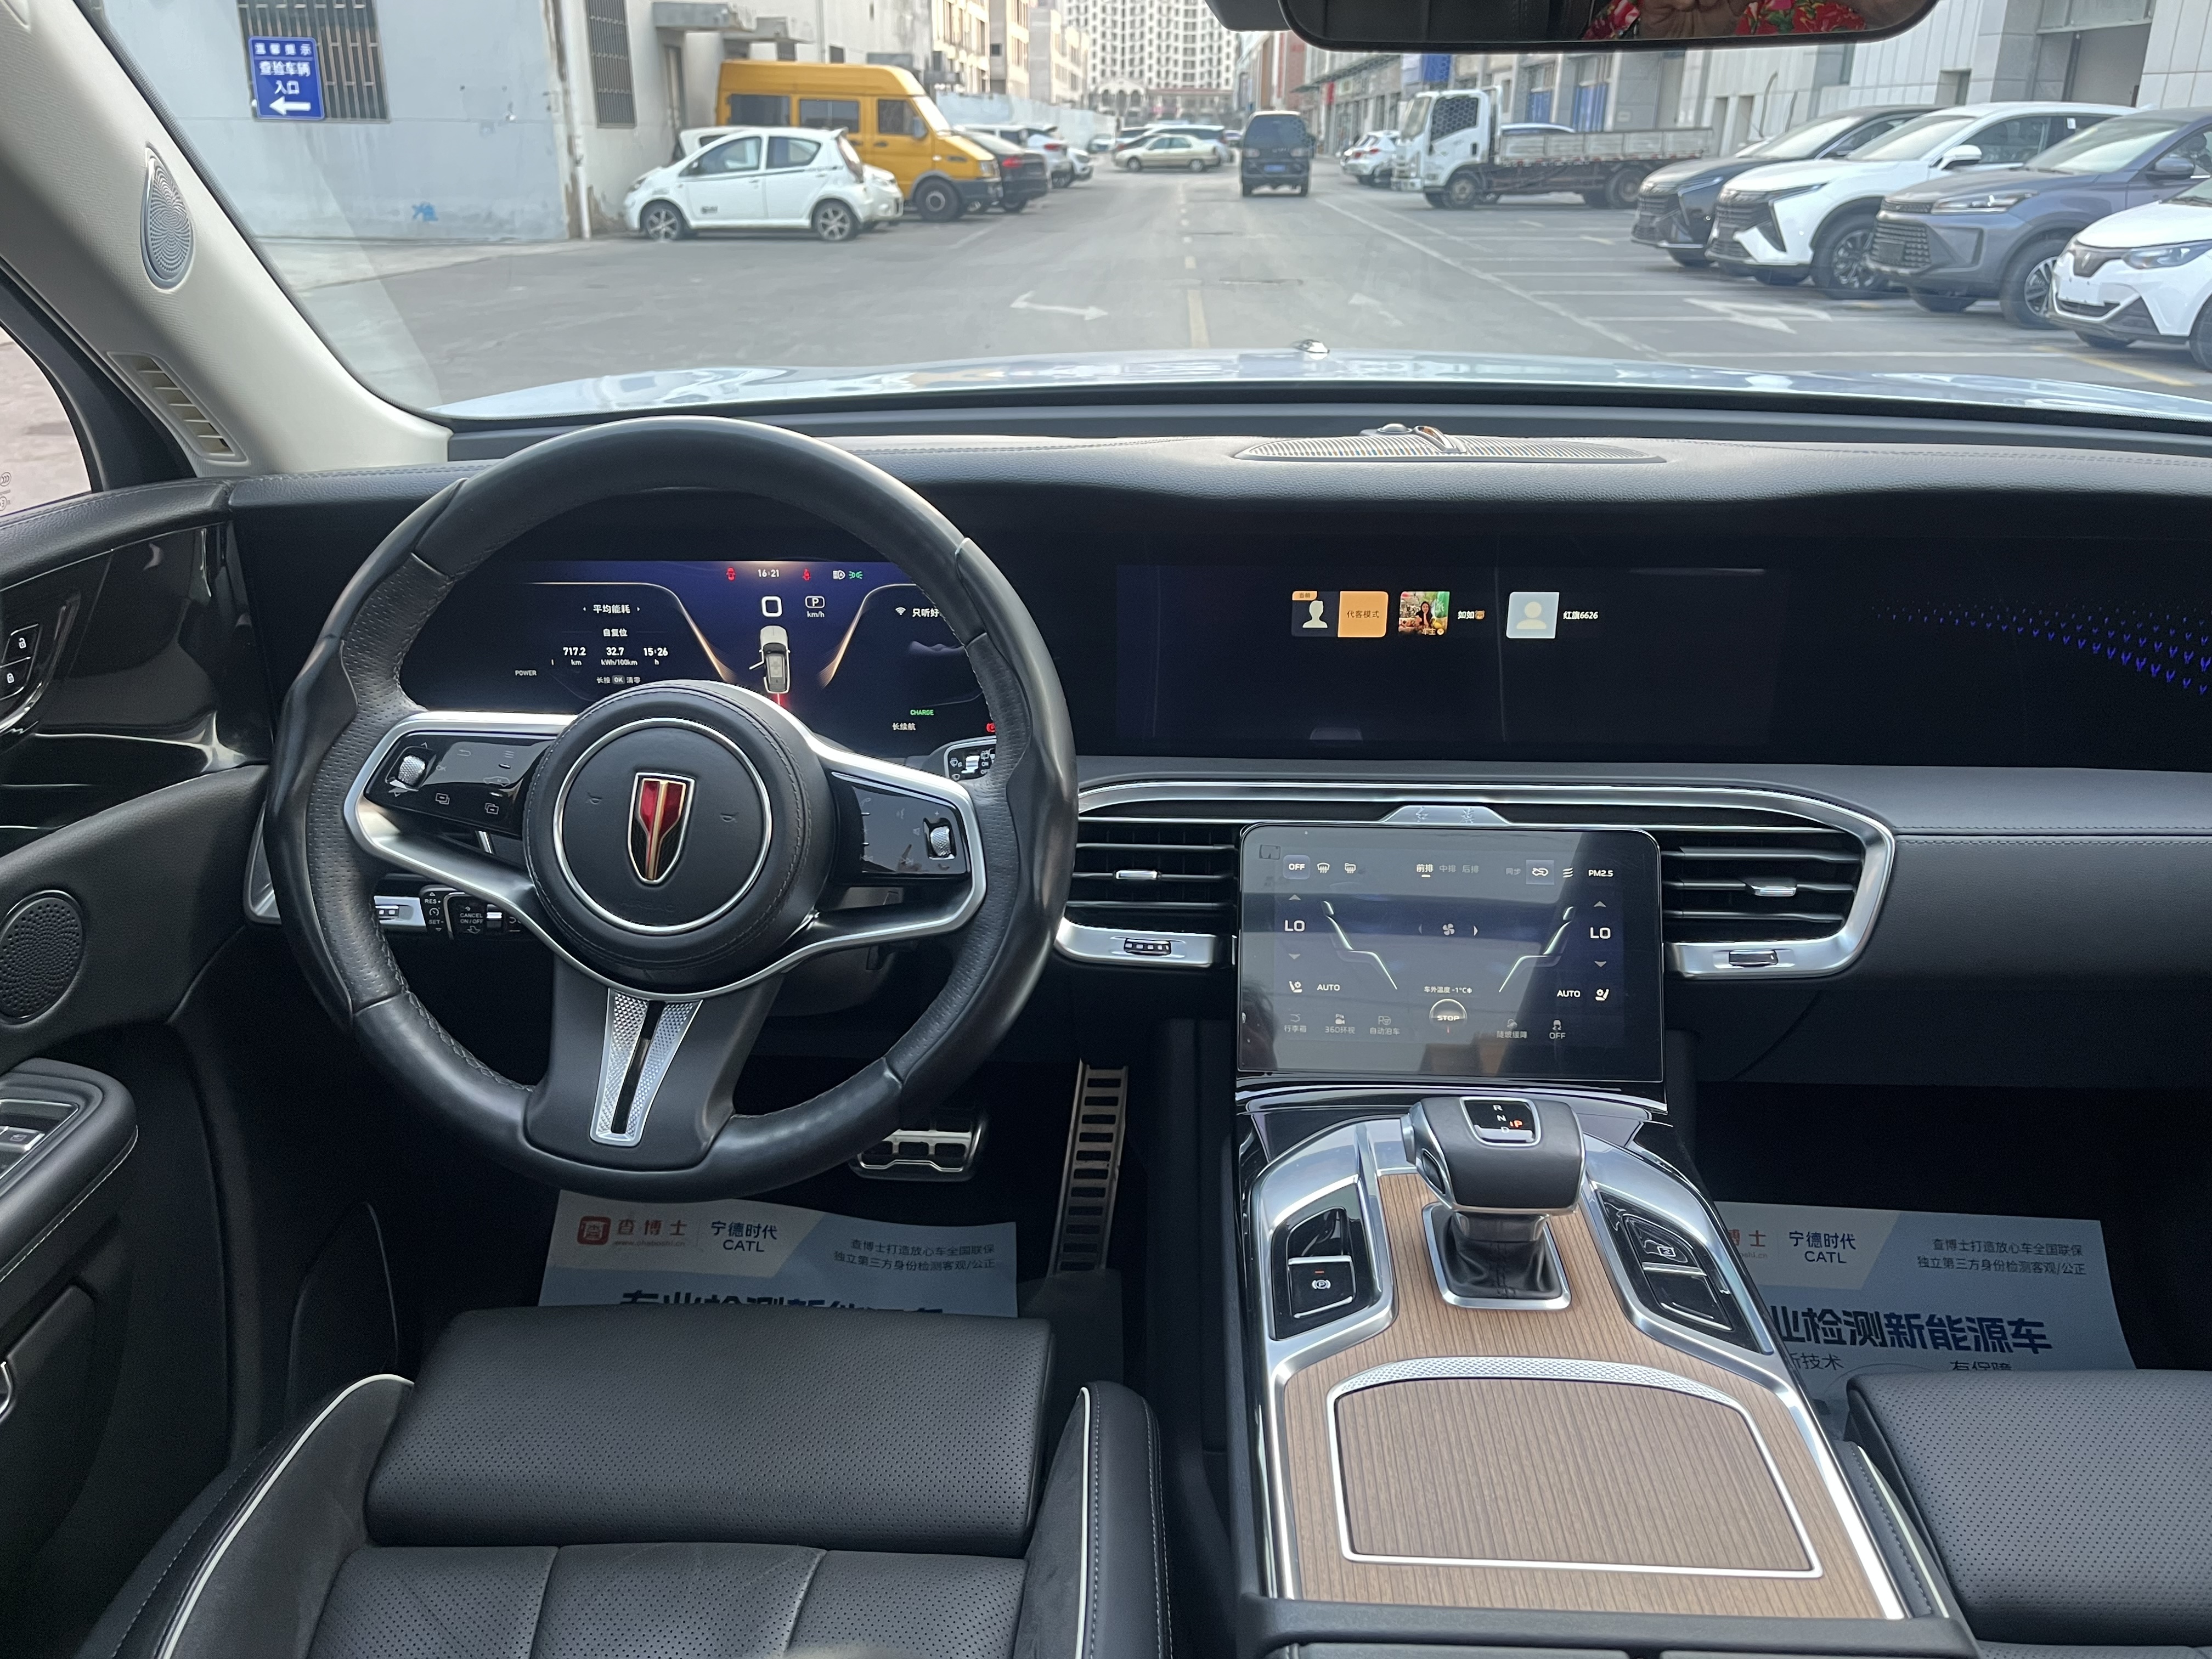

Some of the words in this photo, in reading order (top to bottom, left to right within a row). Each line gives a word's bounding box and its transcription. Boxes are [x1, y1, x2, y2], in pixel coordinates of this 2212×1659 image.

[275, 80, 300, 94] 入口
[593, 605, 630, 613] 平均能耗
[1347, 610, 1380, 619] 代客模式
[1458, 611, 1474, 619] 如如
[1563, 611, 1599, 619] 红旗6626
[603, 628, 628, 637] 自复位
[563, 647, 586, 656] 717.2
[606, 647, 624, 656] 32.7
[644, 648, 668, 656] 15:26
[892, 723, 916, 731] 长续航
[1416, 863, 1434, 872] 前排
[1439, 864, 1457, 873] 中排
[1462, 865, 1480, 873] 后排
[1505, 867, 1522, 876] 同步
[1588, 869, 1613, 877] PM2.5
[1284, 919, 1305, 932] LO
[1590, 927, 1611, 939] LO
[1284, 1025, 1307, 1033] 行李箱
[1325, 1026, 1356, 1034] 360环视
[1497, 1030, 1527, 1039] 陡坡缓降
[617, 1219, 687, 1236] 查博士
[710, 1221, 778, 1240] 宁德时代
[1788, 1230, 1857, 1250] 宁德时代
[723, 1239, 765, 1252] CATL
[850, 1238, 995, 1257] 查博士打造放心车全国联保
[1932, 1238, 2084, 1257] 查博士打造放心车全国联保
[833, 1250, 996, 1272] 独立第三方身份检测客观/公正
[1804, 1250, 1847, 1264] CATL
[1916, 1255, 2087, 1276] 独立第三方身份检测客观/公正
